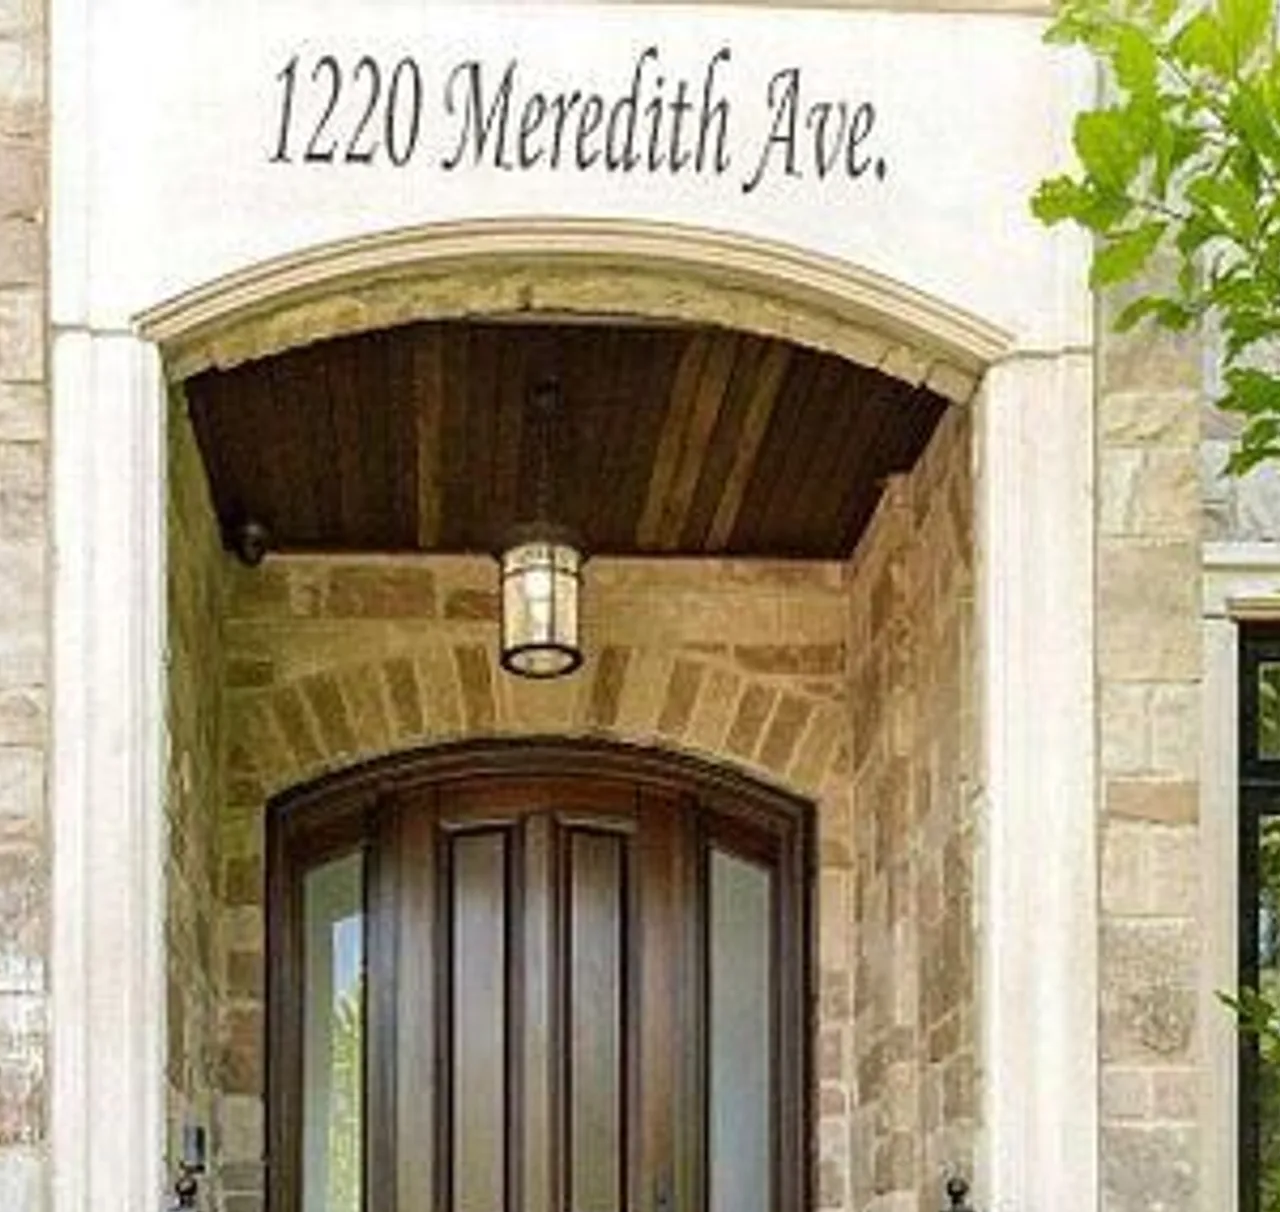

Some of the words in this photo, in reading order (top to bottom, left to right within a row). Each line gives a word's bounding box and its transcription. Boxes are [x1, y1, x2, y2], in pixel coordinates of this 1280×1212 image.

[268, 54, 420, 167] 1220
[439, 46, 732, 174] Meredith
[741, 67, 887, 194] Ave.
